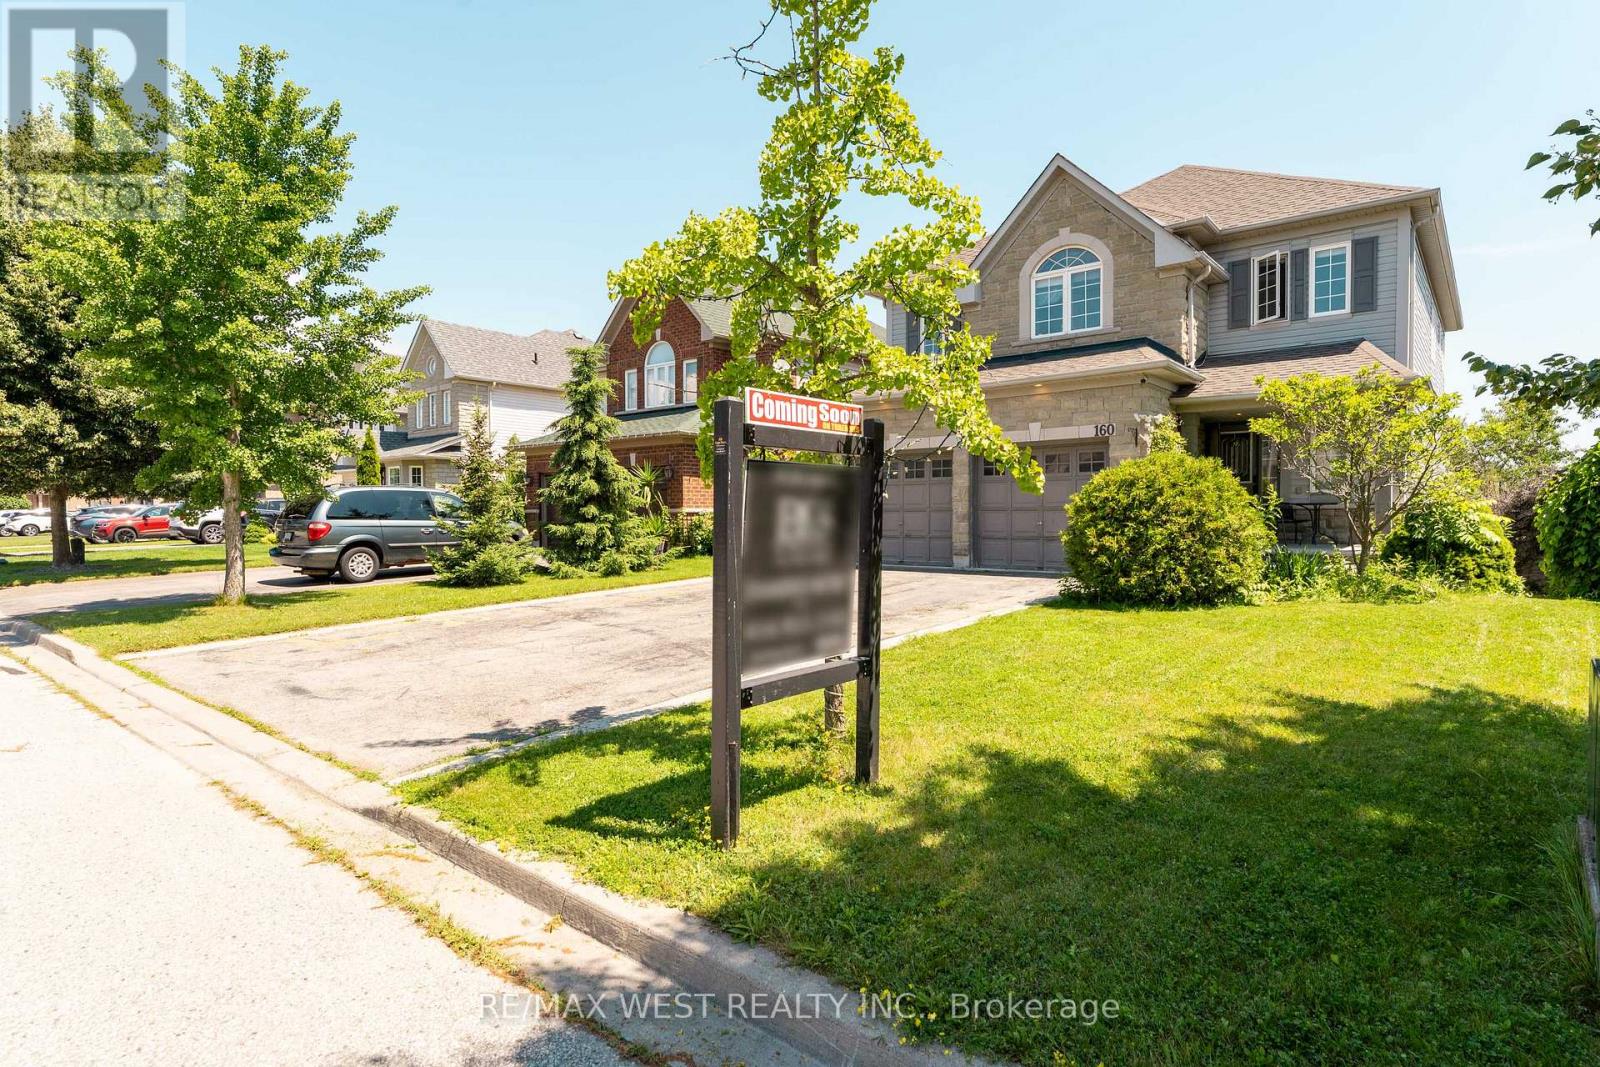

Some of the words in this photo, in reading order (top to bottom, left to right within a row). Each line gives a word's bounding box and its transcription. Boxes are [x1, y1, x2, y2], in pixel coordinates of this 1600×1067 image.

[752, 391, 818, 428] Coming
[818, 403, 860, 426] Soon
[1094, 424, 1115, 437] 160
